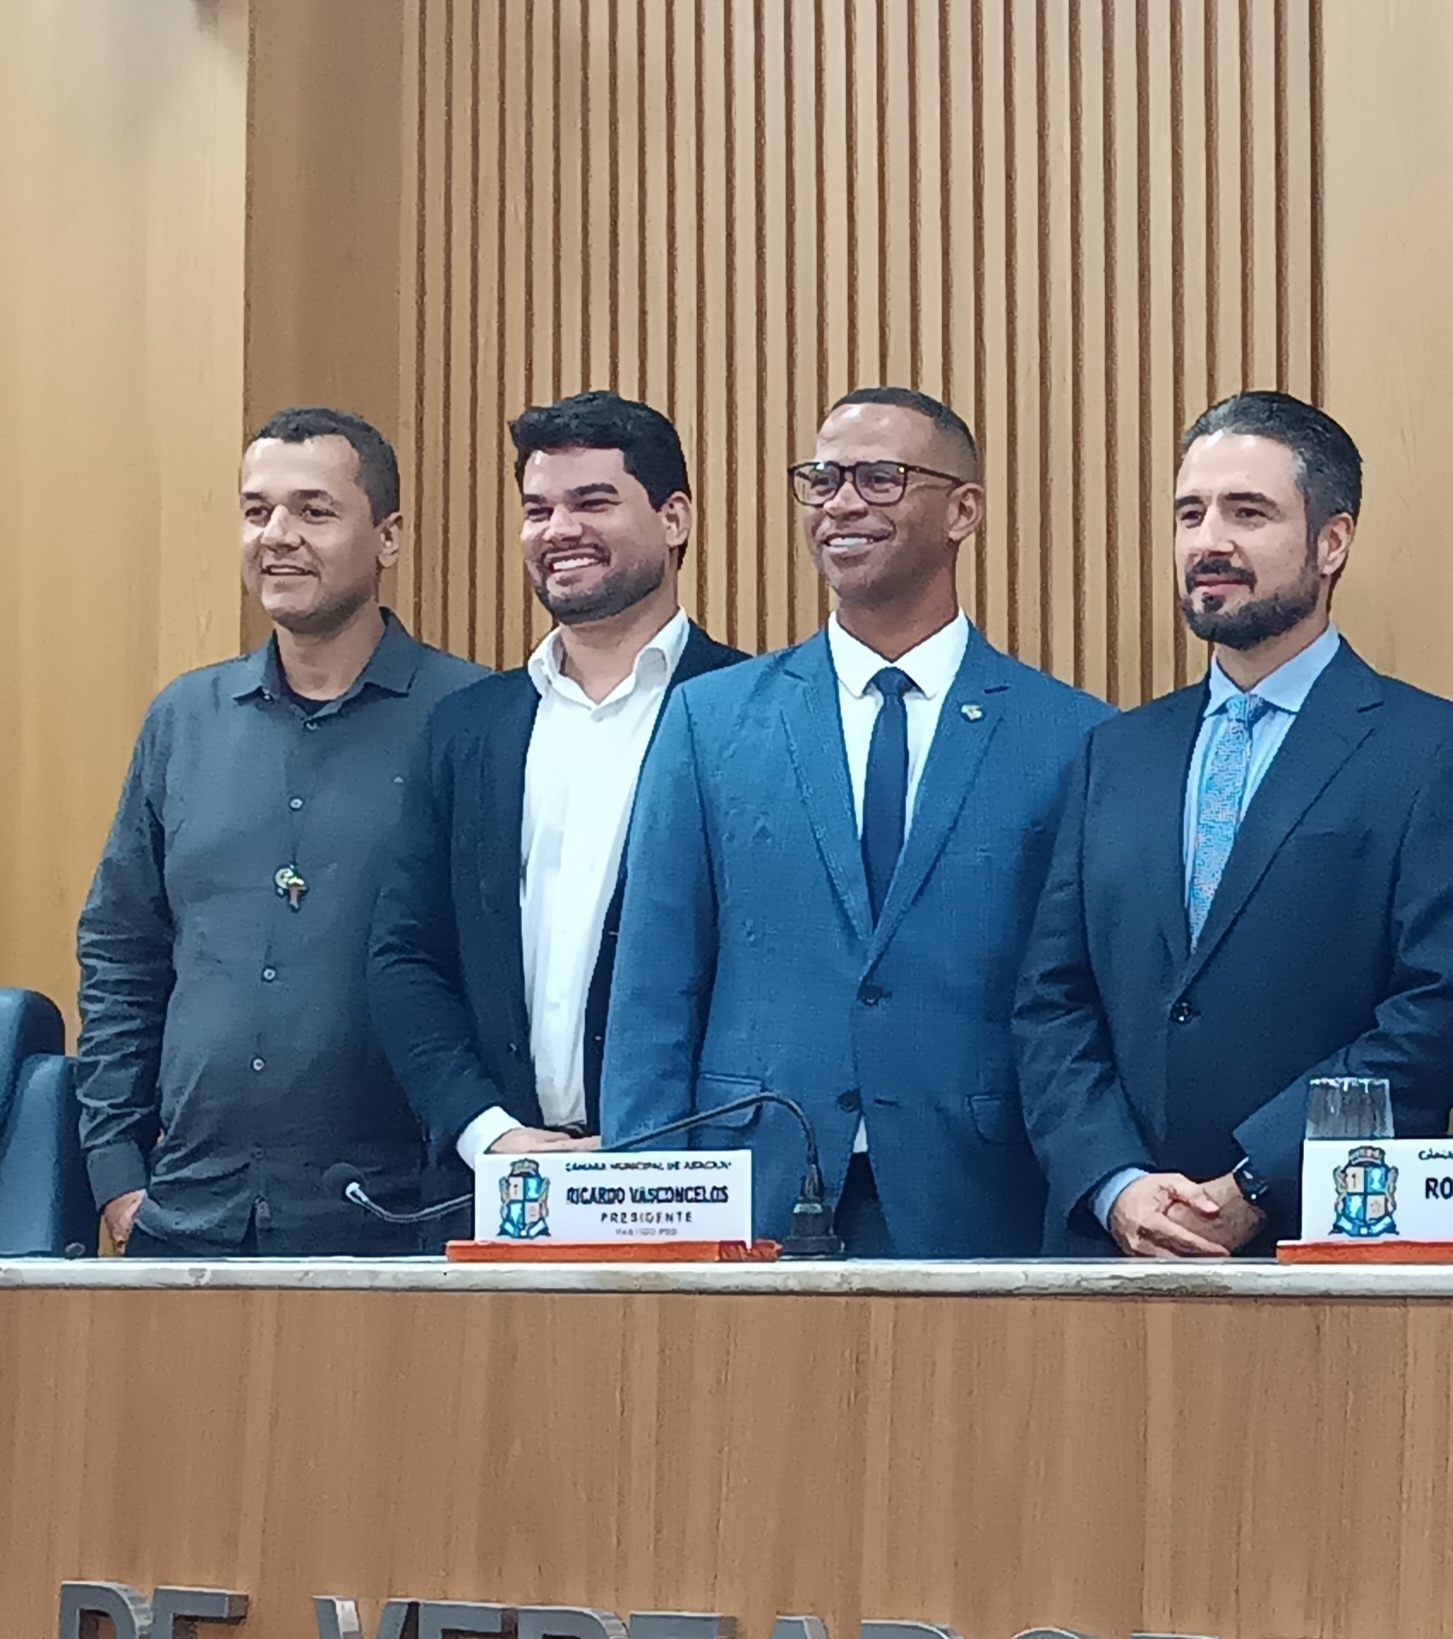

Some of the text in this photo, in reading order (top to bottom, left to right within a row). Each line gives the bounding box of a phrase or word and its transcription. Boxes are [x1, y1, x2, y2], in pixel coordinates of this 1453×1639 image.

[565, 1184, 730, 1206] RICARDO VASCONCELOS
[600, 1210, 693, 1225] PRESIDENTE
